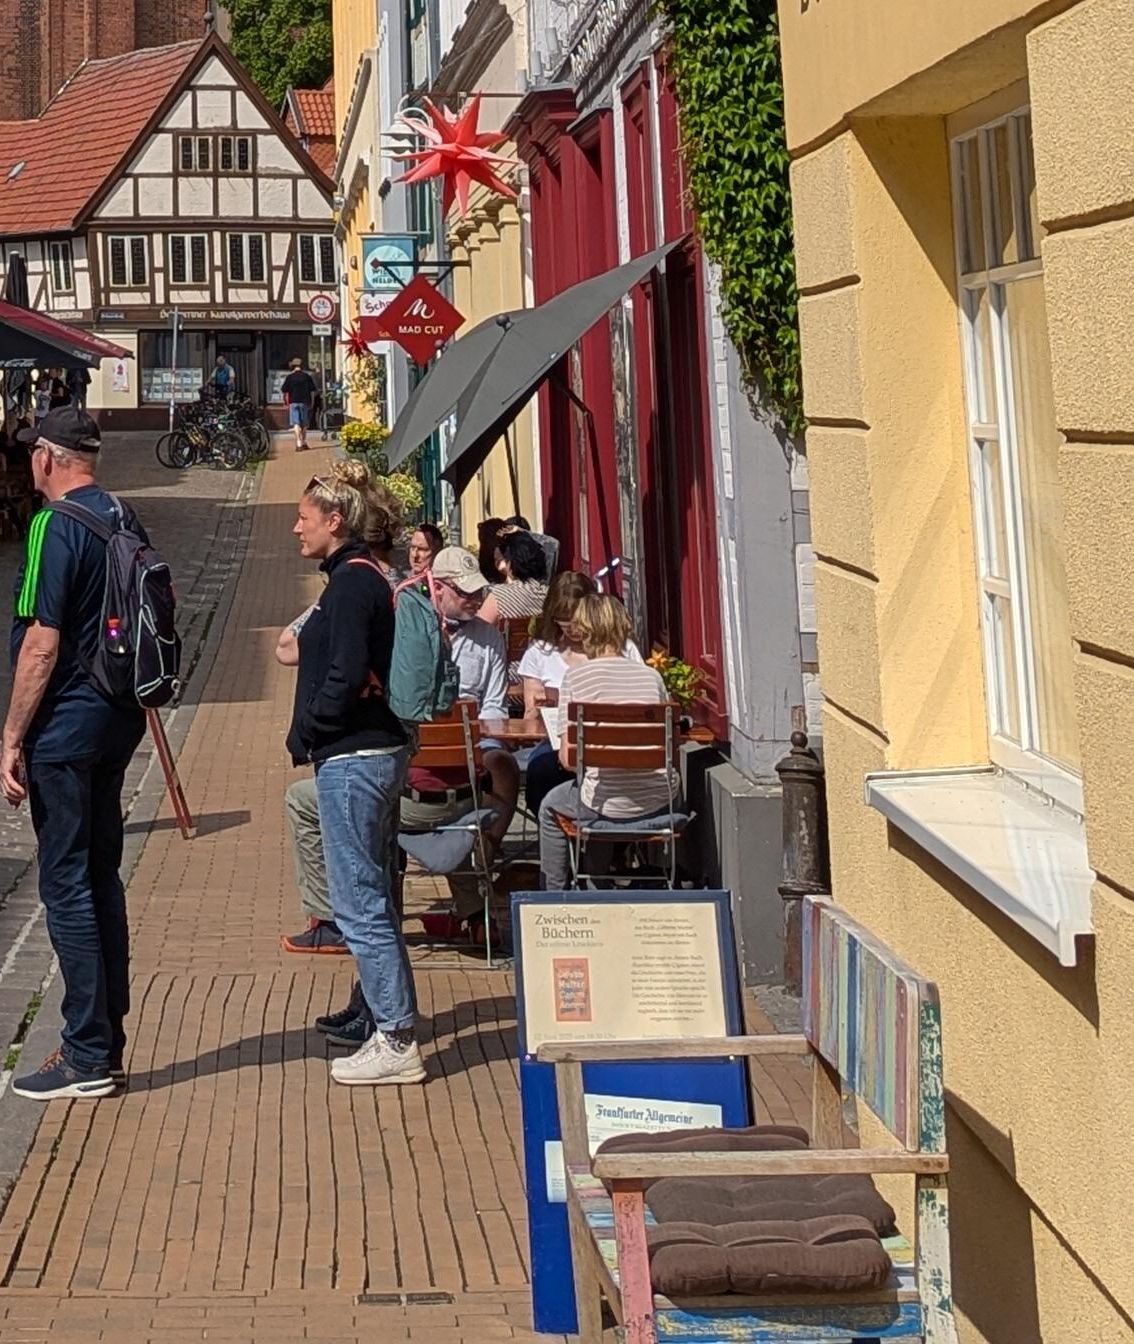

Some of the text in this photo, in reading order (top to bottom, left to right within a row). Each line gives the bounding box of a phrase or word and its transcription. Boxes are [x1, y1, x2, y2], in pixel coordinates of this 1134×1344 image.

[398, 325, 445, 334] MAD CUT
[534, 913, 588, 926] Zwischen
[541, 926, 594, 939] Büchern
[595, 1104, 694, 1125] Frankfurter Allgemeine
